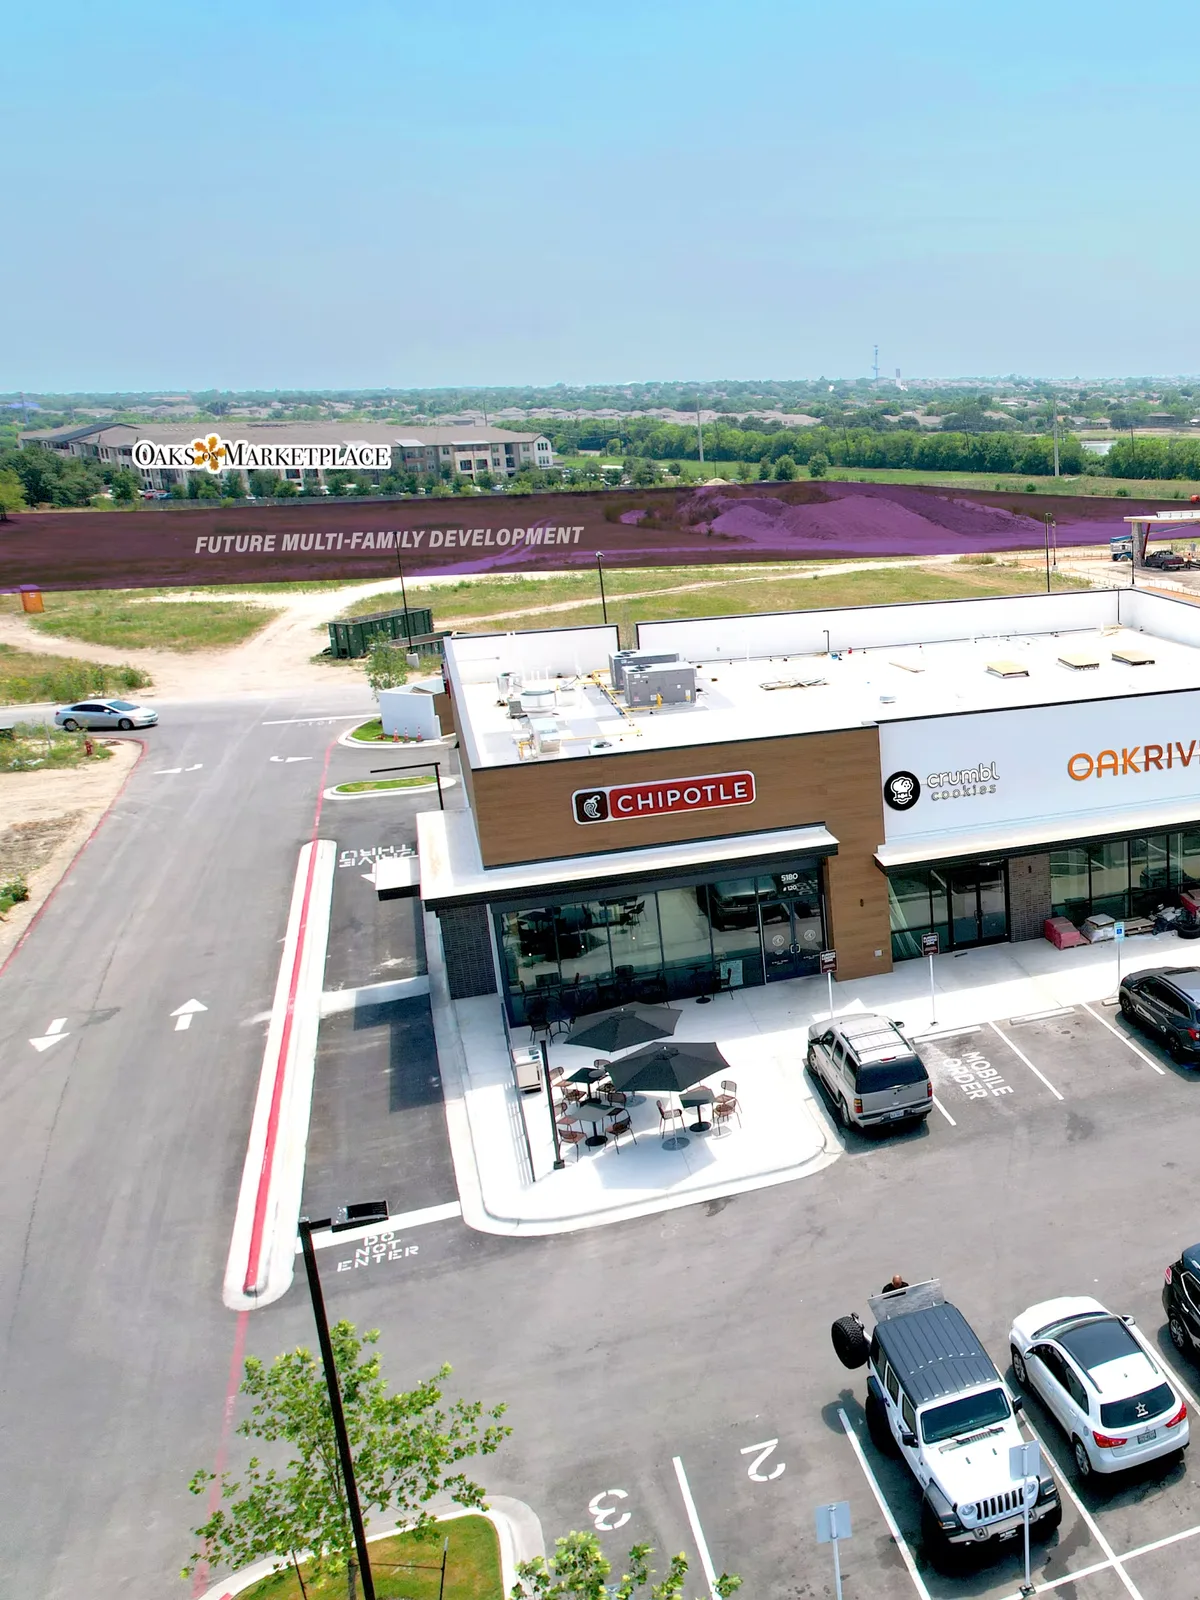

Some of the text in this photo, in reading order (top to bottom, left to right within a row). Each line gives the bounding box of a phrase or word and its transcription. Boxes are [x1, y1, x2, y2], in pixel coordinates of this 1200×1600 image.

[927, 761, 1000, 788] crumbl
[617, 781, 748, 812] CHIPOTLE
[931, 784, 997, 801] cookies
[942, 1058, 988, 1100] ORDER
[962, 1051, 1015, 1097] MOBILE
[355, 1239, 401, 1258] NOT
[364, 1232, 395, 1246] DO
[337, 1246, 419, 1272] ENTER
[740, 1438, 786, 1482] 2
[589, 1489, 632, 1531] 3
